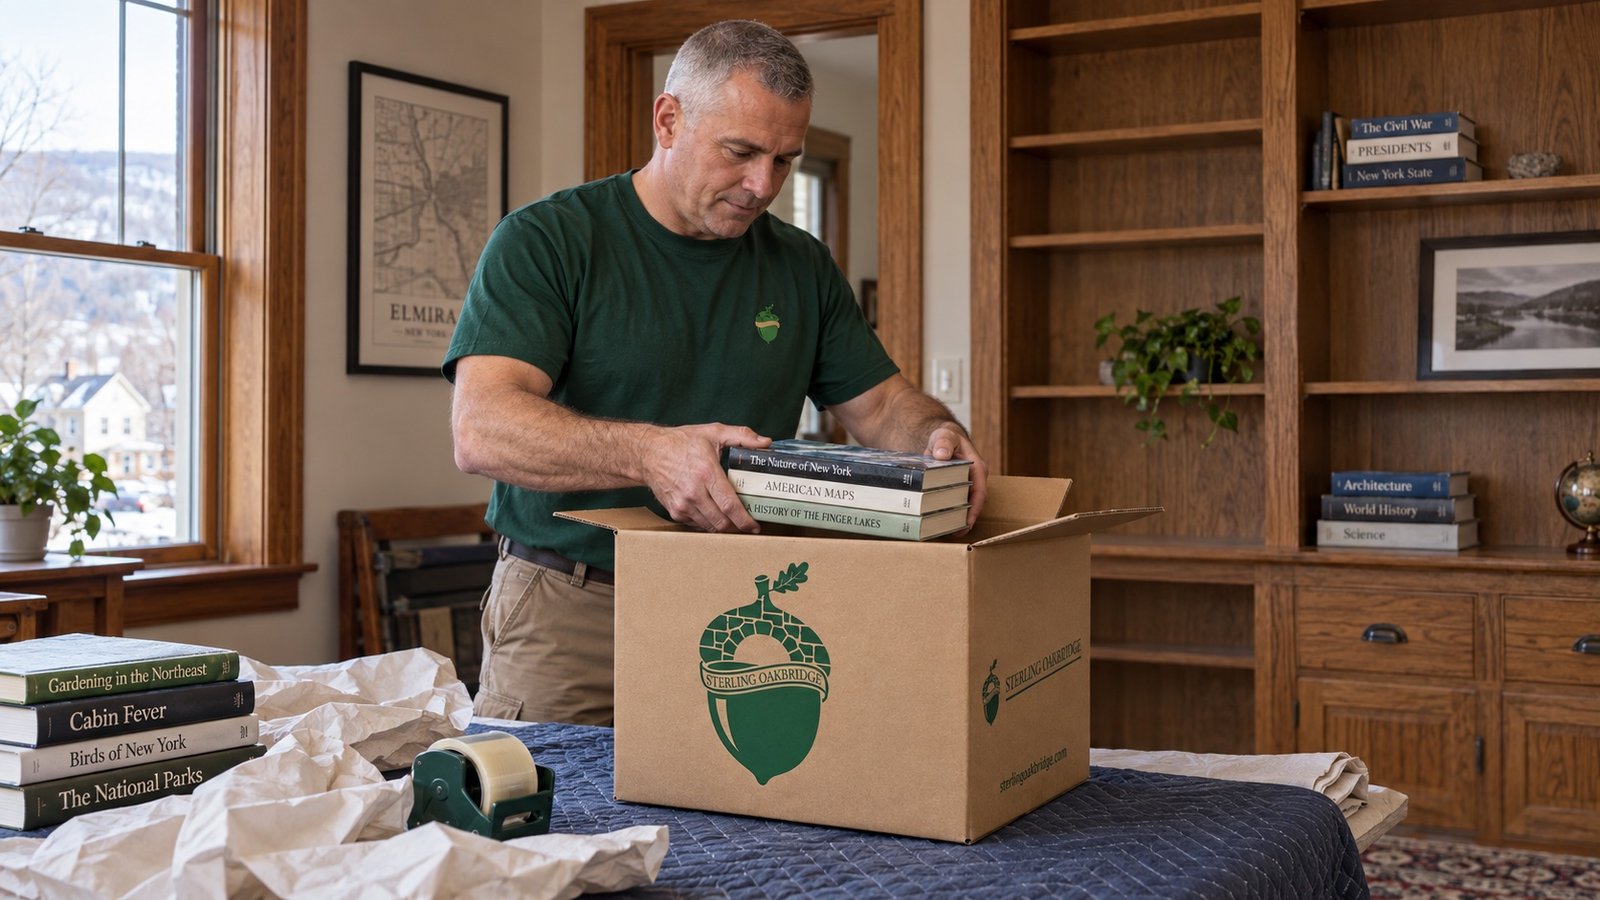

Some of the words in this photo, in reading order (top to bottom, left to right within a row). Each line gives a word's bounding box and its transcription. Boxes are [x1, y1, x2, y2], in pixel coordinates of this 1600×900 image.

[1361, 122, 1382, 133] The
[1384, 120, 1408, 132] Civil
[1410, 118, 1433, 130] War
[1358, 141, 1432, 157] PRESIDENTS
[1357, 170, 1379, 182] New
[1381, 168, 1405, 180] York
[1408, 168, 1433, 178] State
[390, 303, 457, 325] ELMIRA
[750, 455, 766, 467] The
[768, 457, 797, 470] Nature
[799, 461, 810, 472] of
[809, 462, 830, 474] New
[831, 464, 852, 477] York
[764, 480, 821, 497] AMERICAN
[824, 487, 855, 501] MAPS
[1343, 479, 1413, 492] Architecture
[754, 503, 789, 517] HISTORY
[790, 507, 801, 518] OF
[803, 509, 820, 521] THE
[822, 511, 852, 526] FINGER
[854, 515, 881, 529] LAKES
[1343, 503, 1376, 515] World
[1379, 503, 1418, 519] History
[1343, 527, 1386, 540] Science
[1004, 659, 1042, 693] STERLING
[1042, 638, 1082, 672] OAKBRIDGE
[48, 672, 112, 694] Gardening
[116, 670, 128, 685] in
[130, 667, 150, 684] the
[152, 662, 208, 682] Northeast
[706, 673, 757, 689] STERLING
[759, 669, 822, 686] OAKBRIDGE
[69, 709, 119, 732] Cabin
[123, 704, 167, 725] Fever
[69, 748, 105, 768] Birds
[108, 744, 123, 761] of
[125, 740, 154, 759] New
[157, 734, 187, 753] York
[58, 789, 91, 811] The
[95, 773, 159, 804] National
[163, 766, 203, 790] Parks
